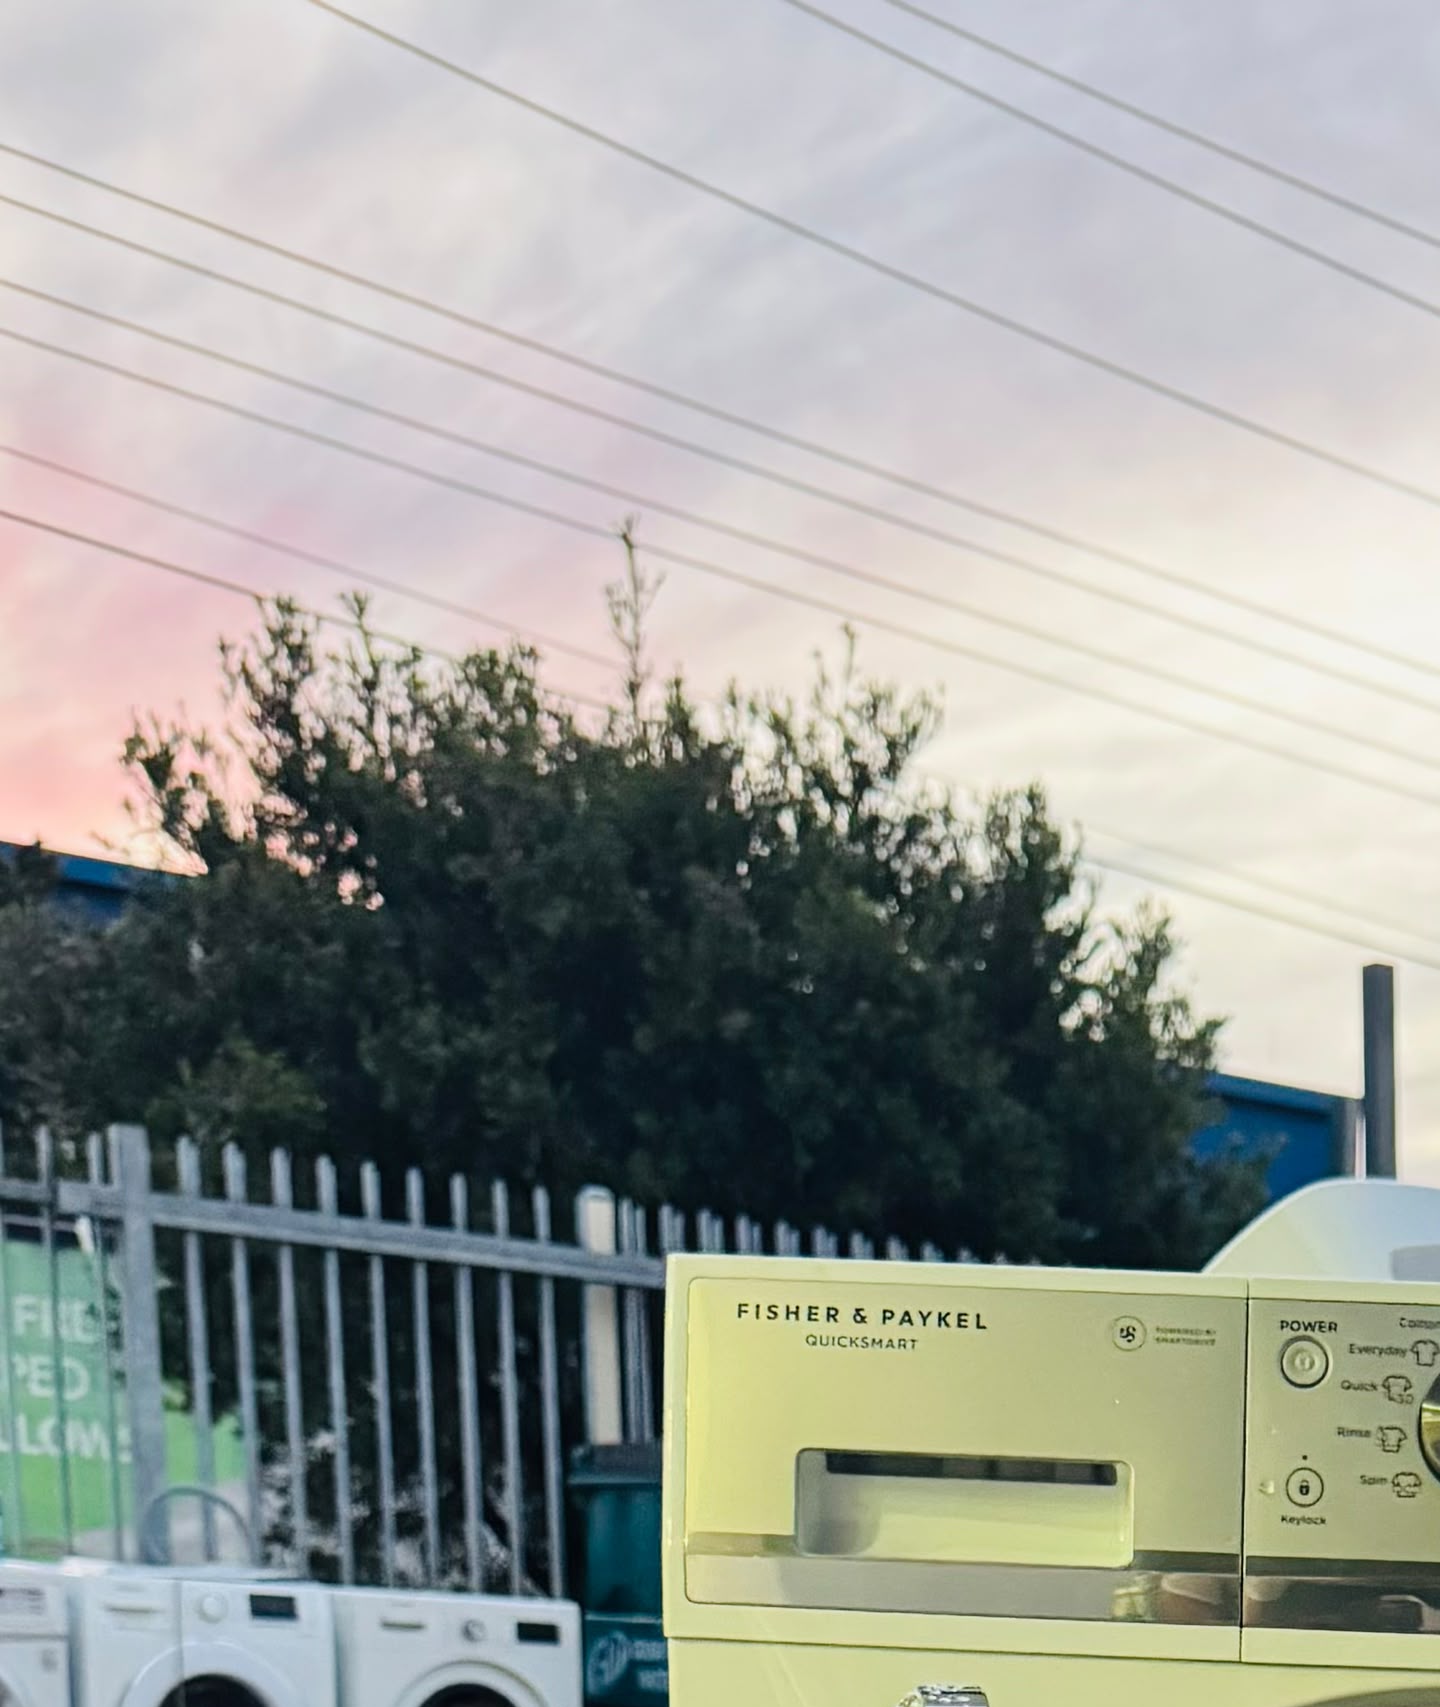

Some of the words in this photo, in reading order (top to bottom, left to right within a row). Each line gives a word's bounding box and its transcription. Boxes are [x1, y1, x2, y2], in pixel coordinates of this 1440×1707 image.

[737, 1303, 840, 1324] FISHER
[852, 1308, 867, 1325] &
[882, 1309, 988, 1330] PAYKEL
[1280, 1320, 1338, 1333] POWER
[805, 1334, 918, 1350] QUICKSMART
[1349, 1343, 1407, 1358] Everyday
[1340, 1380, 1378, 1391] Quick
[1337, 1427, 1372, 1438] Rinse
